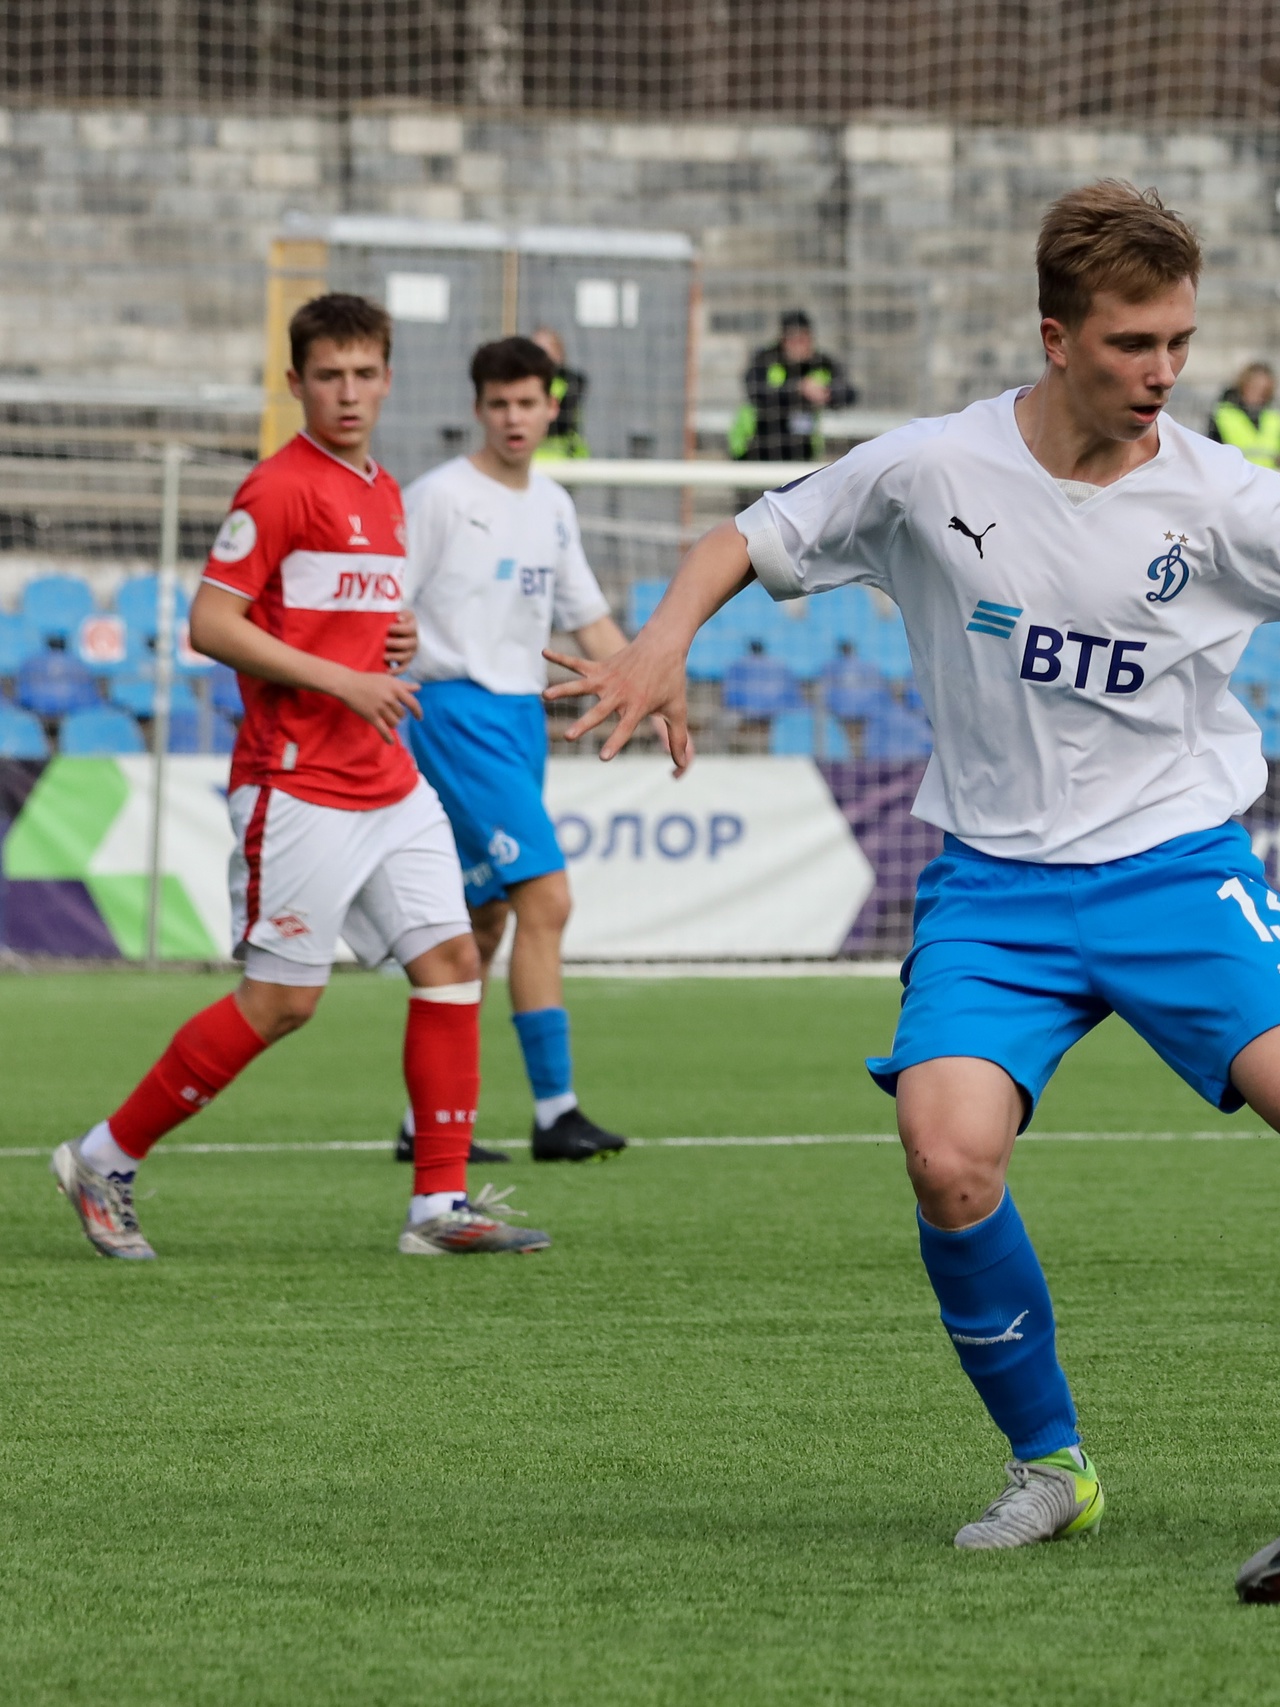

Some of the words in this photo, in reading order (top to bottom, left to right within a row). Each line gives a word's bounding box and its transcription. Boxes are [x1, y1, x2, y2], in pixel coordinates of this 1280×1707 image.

[333, 571, 403, 600] ЛУКО
[520, 566, 555, 596] ВТ
[1019, 624, 1148, 694] ВТБ
[556, 812, 744, 859] ОЛОР
